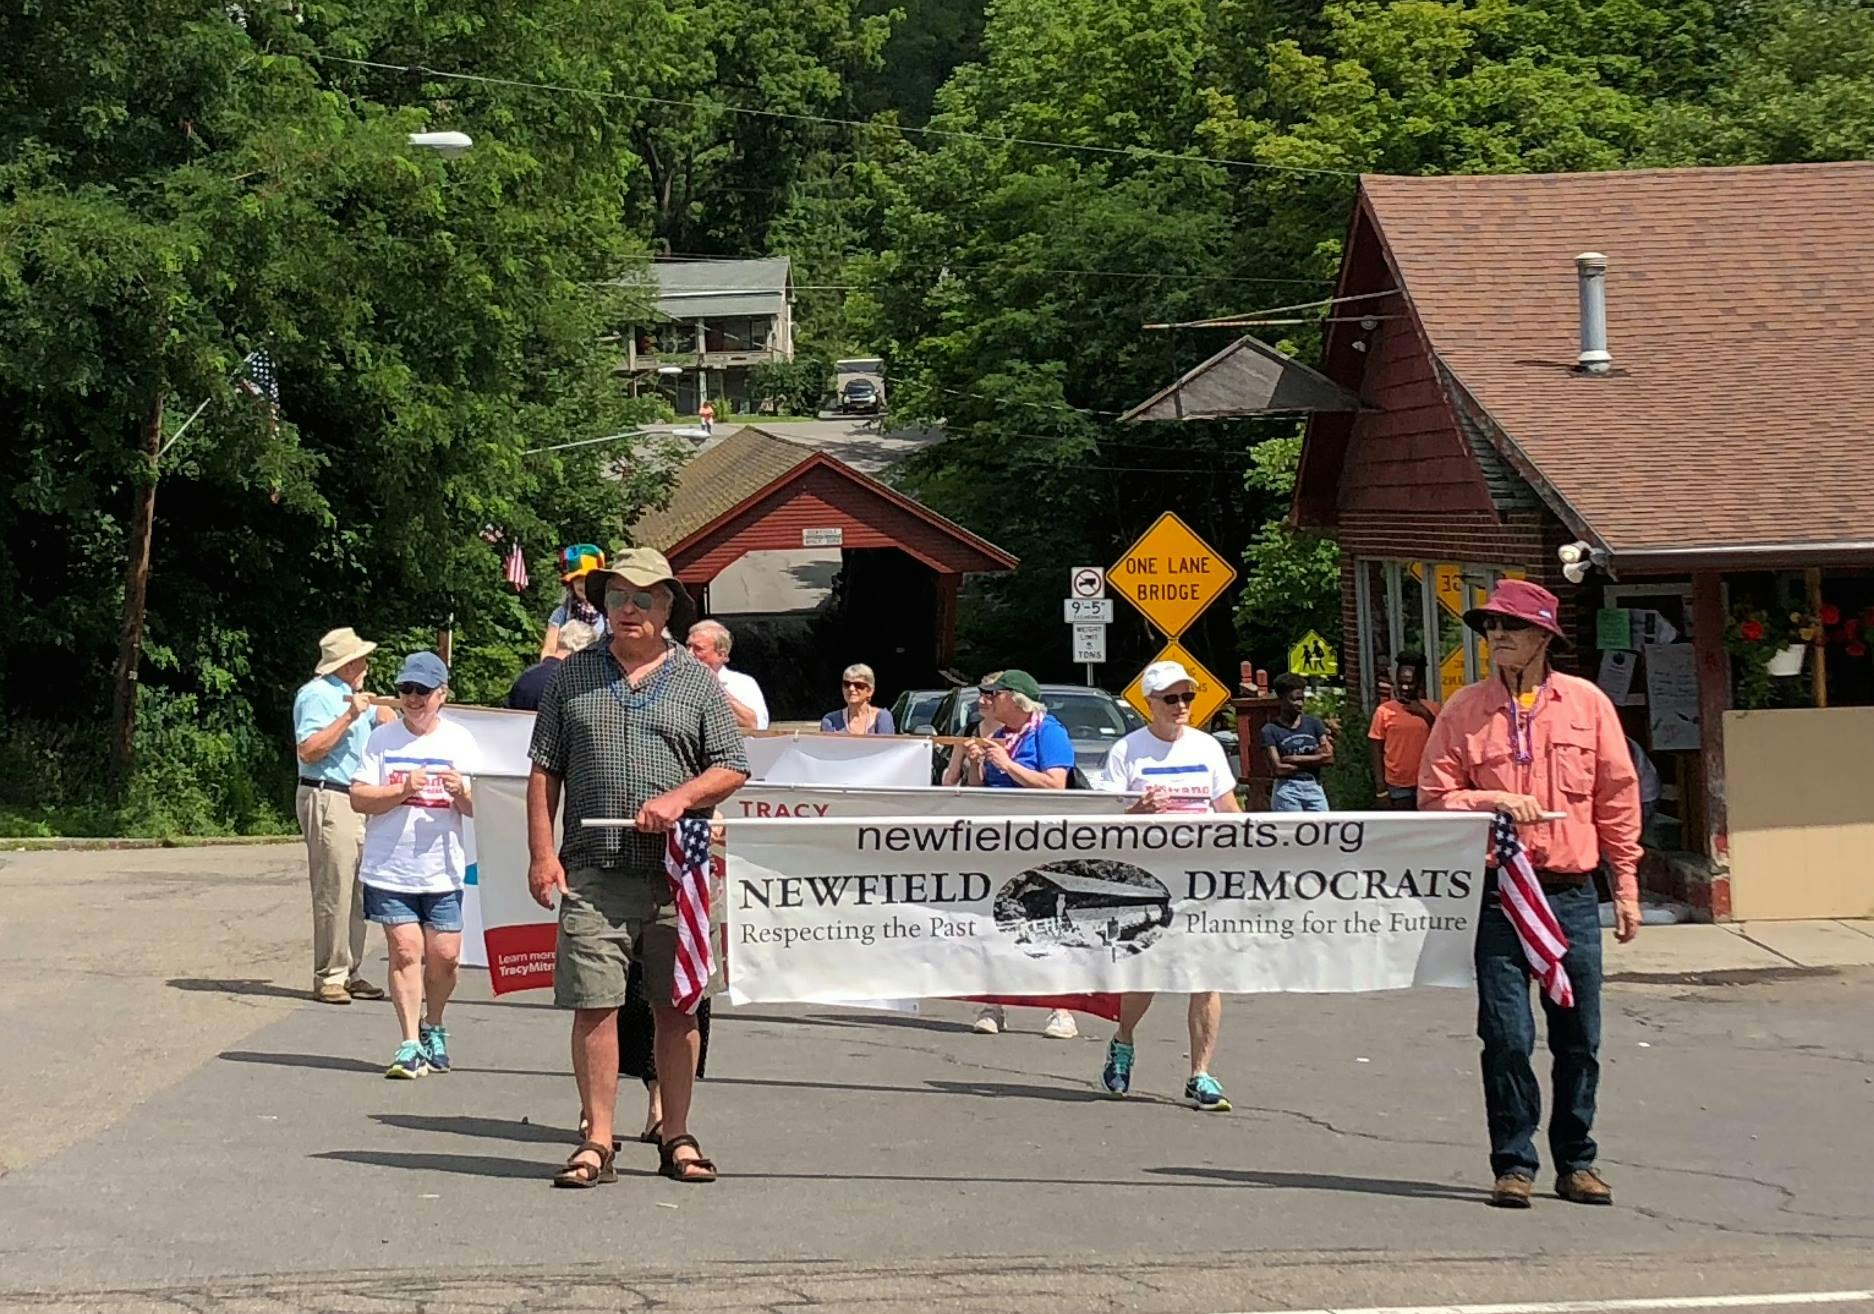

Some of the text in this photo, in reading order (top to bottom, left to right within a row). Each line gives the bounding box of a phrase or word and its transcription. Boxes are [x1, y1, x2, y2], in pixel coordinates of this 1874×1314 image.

[1126, 557, 1211, 575] ONE LANE
[1137, 584, 1200, 601] BRIDGE
[1078, 650, 1102, 659] TONS
[739, 801, 829, 818] TRACY
[858, 818, 1365, 853] newfielddemocrats.org
[739, 868, 1472, 909] NEWFIELD DEMOCRATS
[741, 911, 1468, 948] Respecting the Past Planning for the Future
[498, 953, 528, 964] Learn
